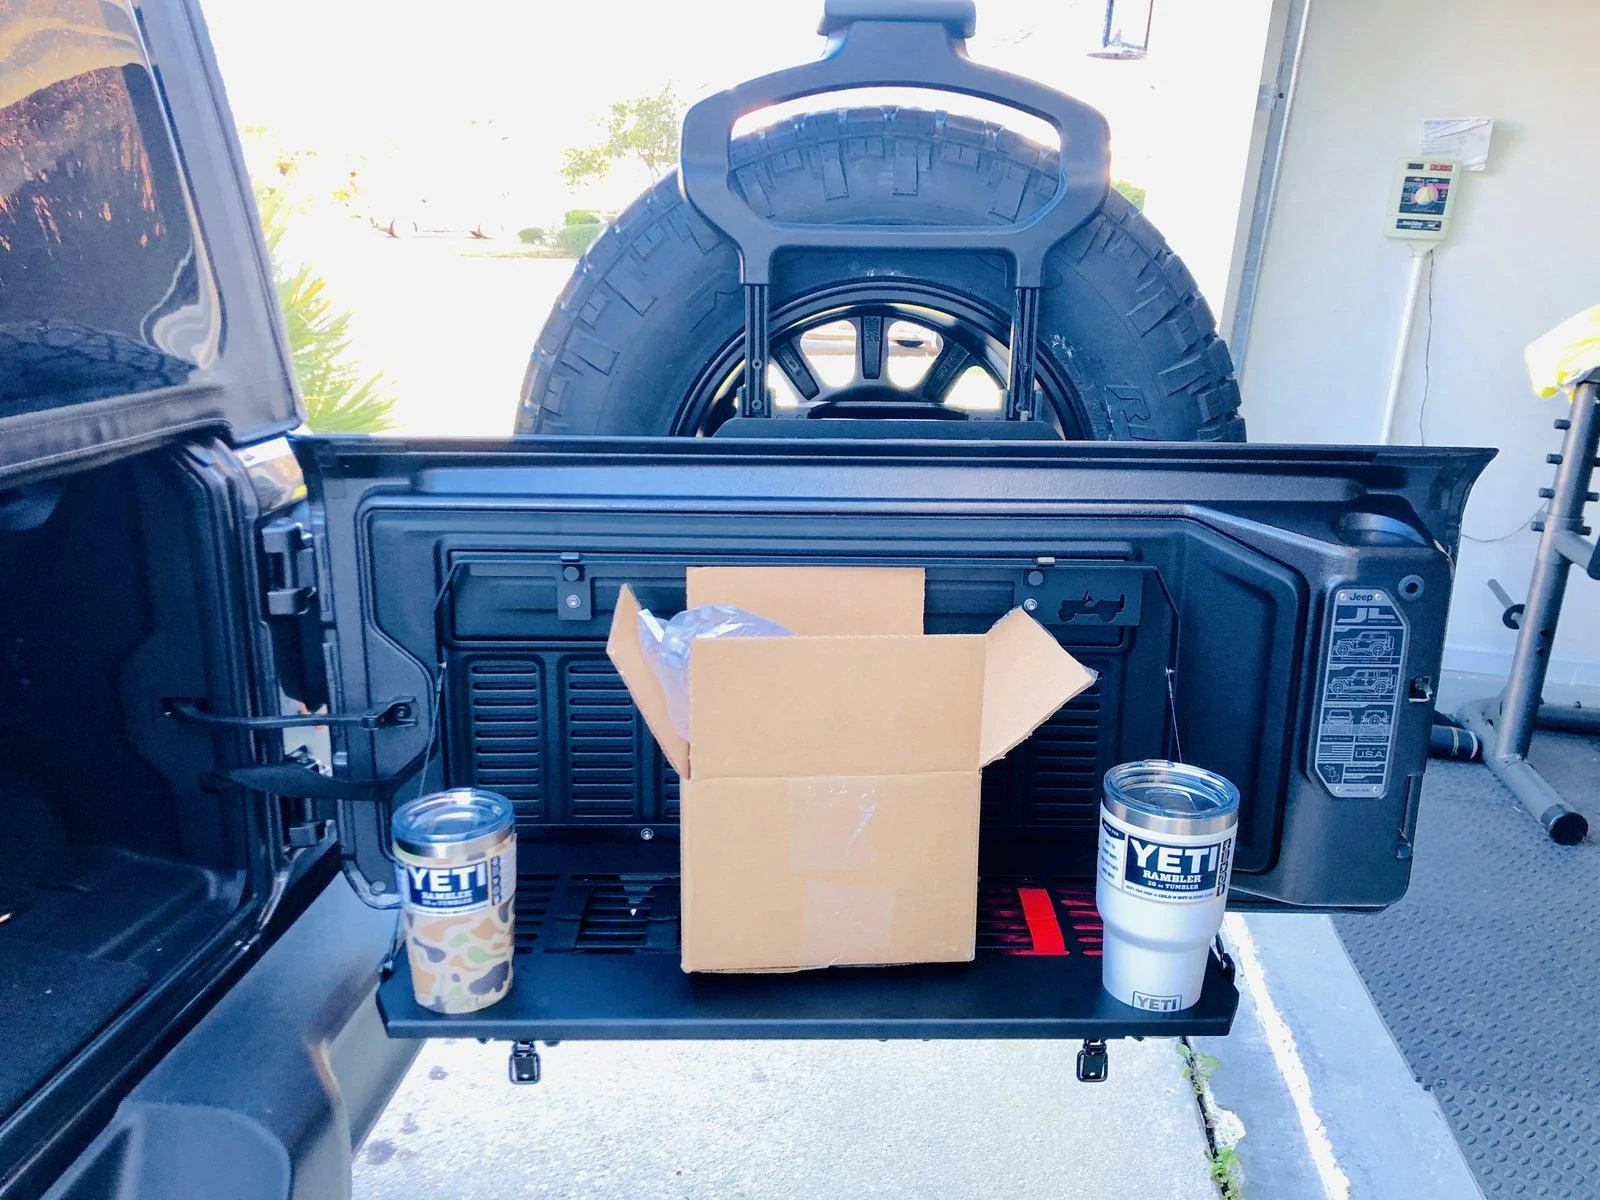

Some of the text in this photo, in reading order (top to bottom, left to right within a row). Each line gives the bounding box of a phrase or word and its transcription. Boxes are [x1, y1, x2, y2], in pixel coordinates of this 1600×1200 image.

[1349, 592, 1373, 602] Jeep
[1336, 607, 1396, 623] JL
[1354, 750, 1385, 758] U.S.A.
[1129, 838, 1219, 874] YETI
[408, 861, 487, 892] YETI
[1142, 869, 1202, 883] RAMBLER
[1137, 995, 1177, 1010] YETI
